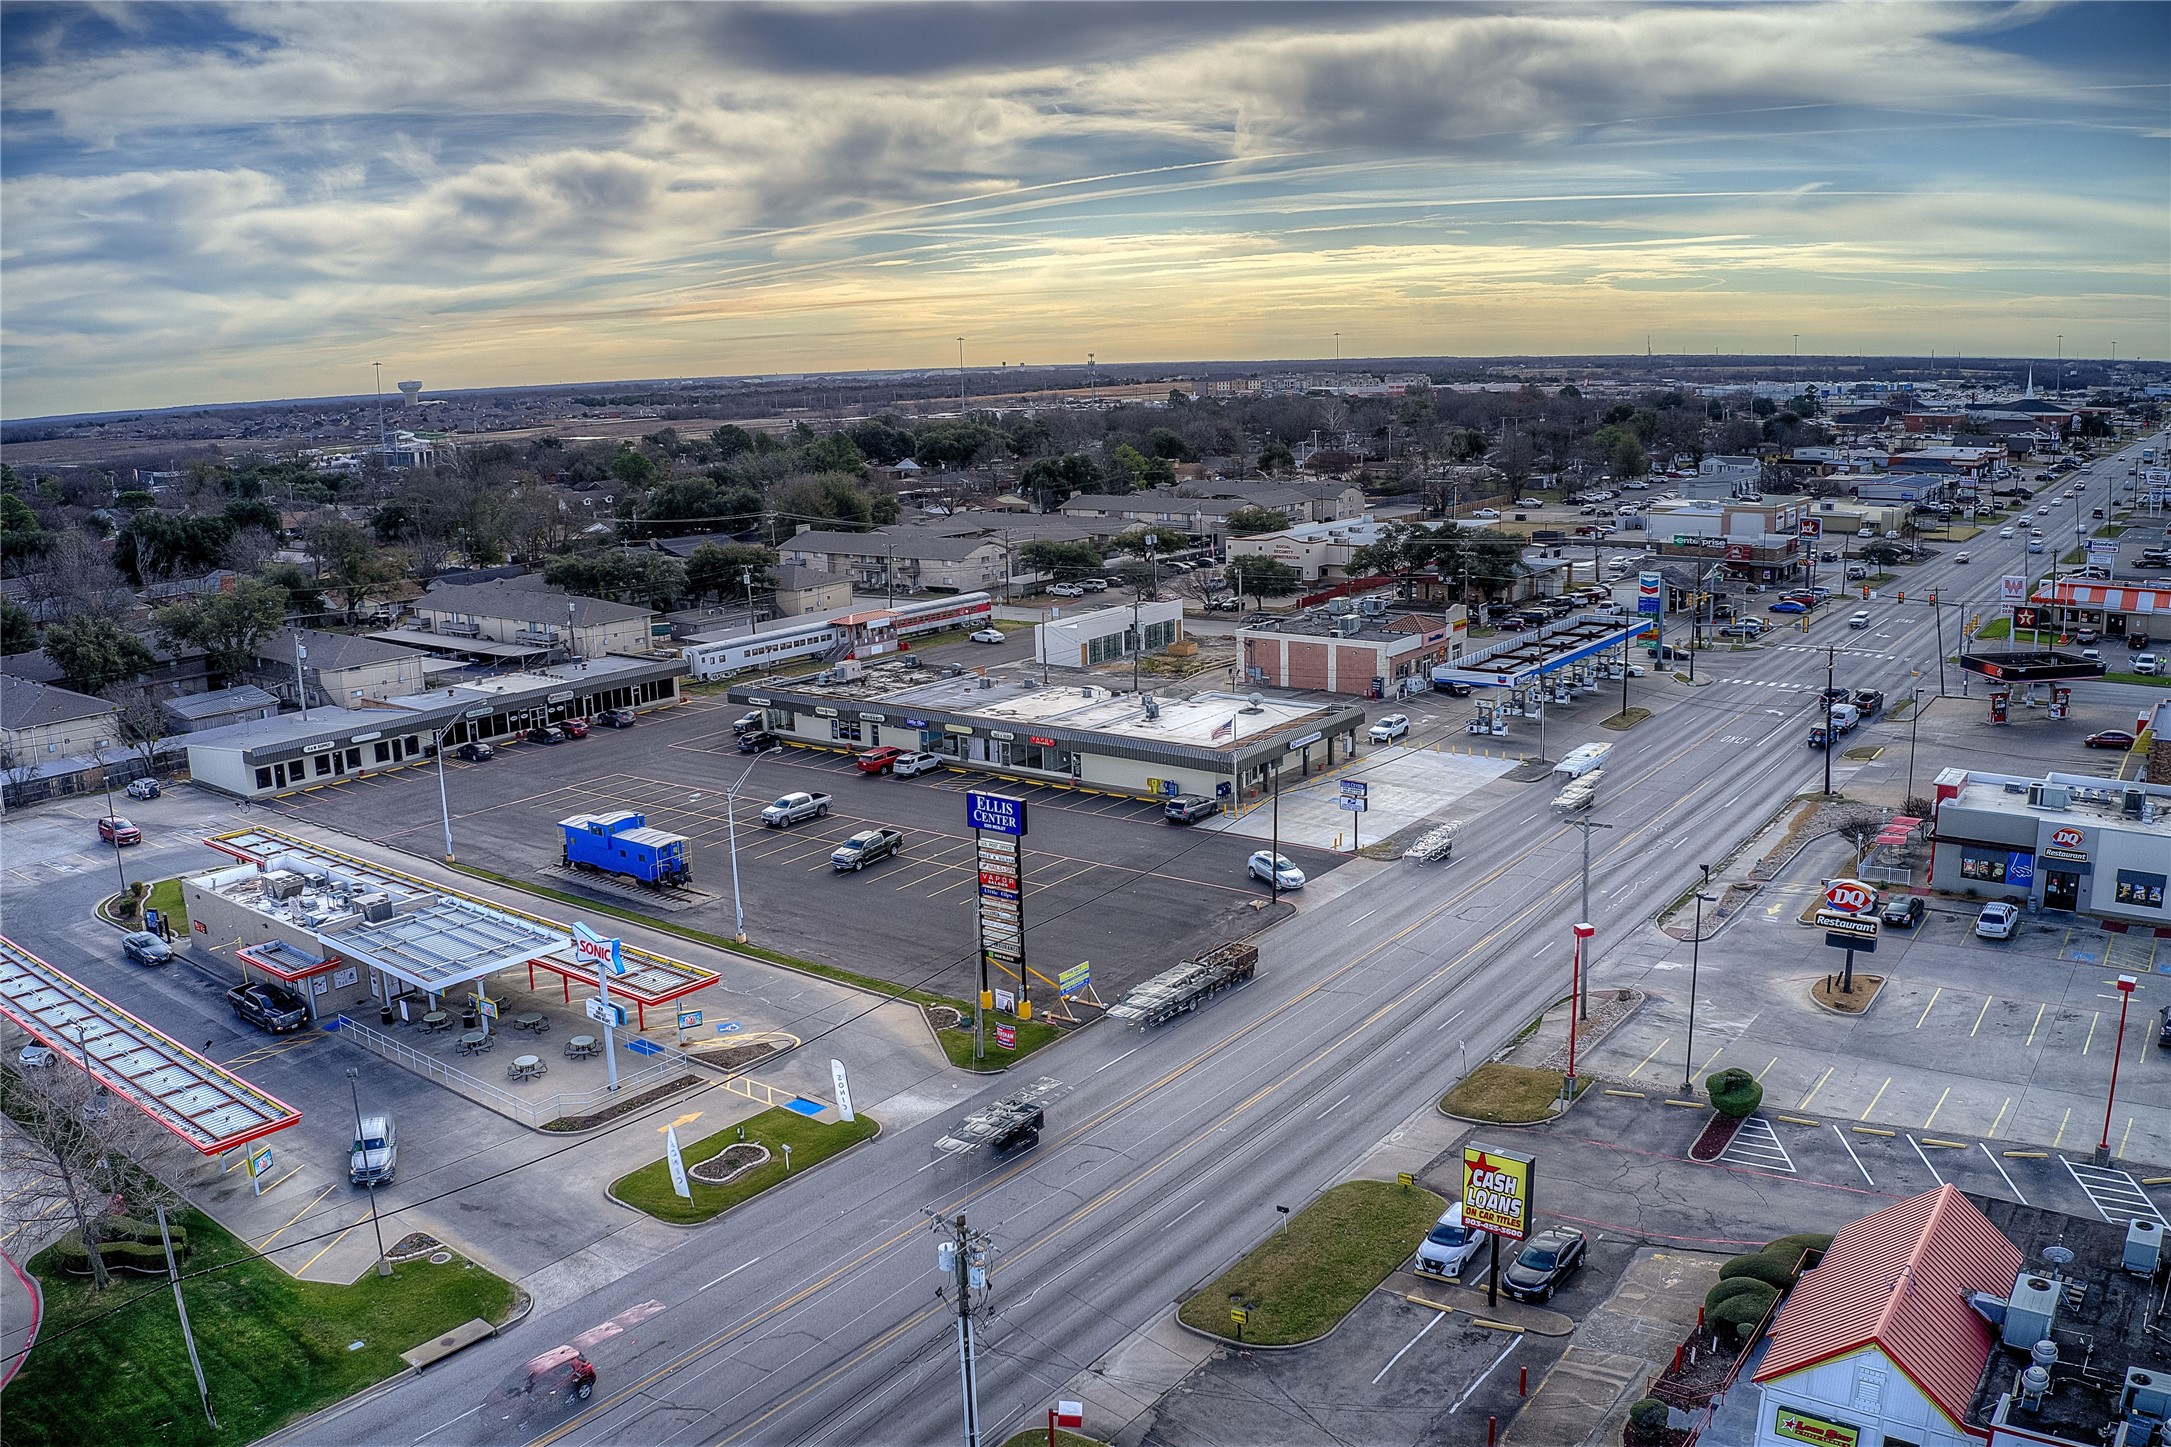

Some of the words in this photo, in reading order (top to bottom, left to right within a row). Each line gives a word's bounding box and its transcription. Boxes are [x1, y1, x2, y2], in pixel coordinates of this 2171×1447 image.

[1801, 522, 1818, 534] Jack
[1676, 536, 1726, 547] enteprise
[1031, 736, 1054, 744] VAPOR
[1720, 735, 1751, 744] ONLY
[976, 795, 1013, 815] ELLIS
[973, 809, 1017, 828] CENTER
[2057, 831, 2079, 846] DQ
[2045, 849, 2087, 861] Restaurant
[982, 873, 1014, 884] VAPOR
[1000, 890, 1013, 898] Clips
[1833, 888, 1865, 908] DQ
[1817, 915, 1876, 933] Restaurant
[580, 940, 611, 962] SONIC
[1473, 1169, 1518, 1195] CASH
[1466, 1187, 1523, 1218] LOANS
[1466, 1207, 1476, 1217] ON
[1479, 1211, 1494, 1221] CAR
[1497, 1215, 1522, 1228] TITLES
